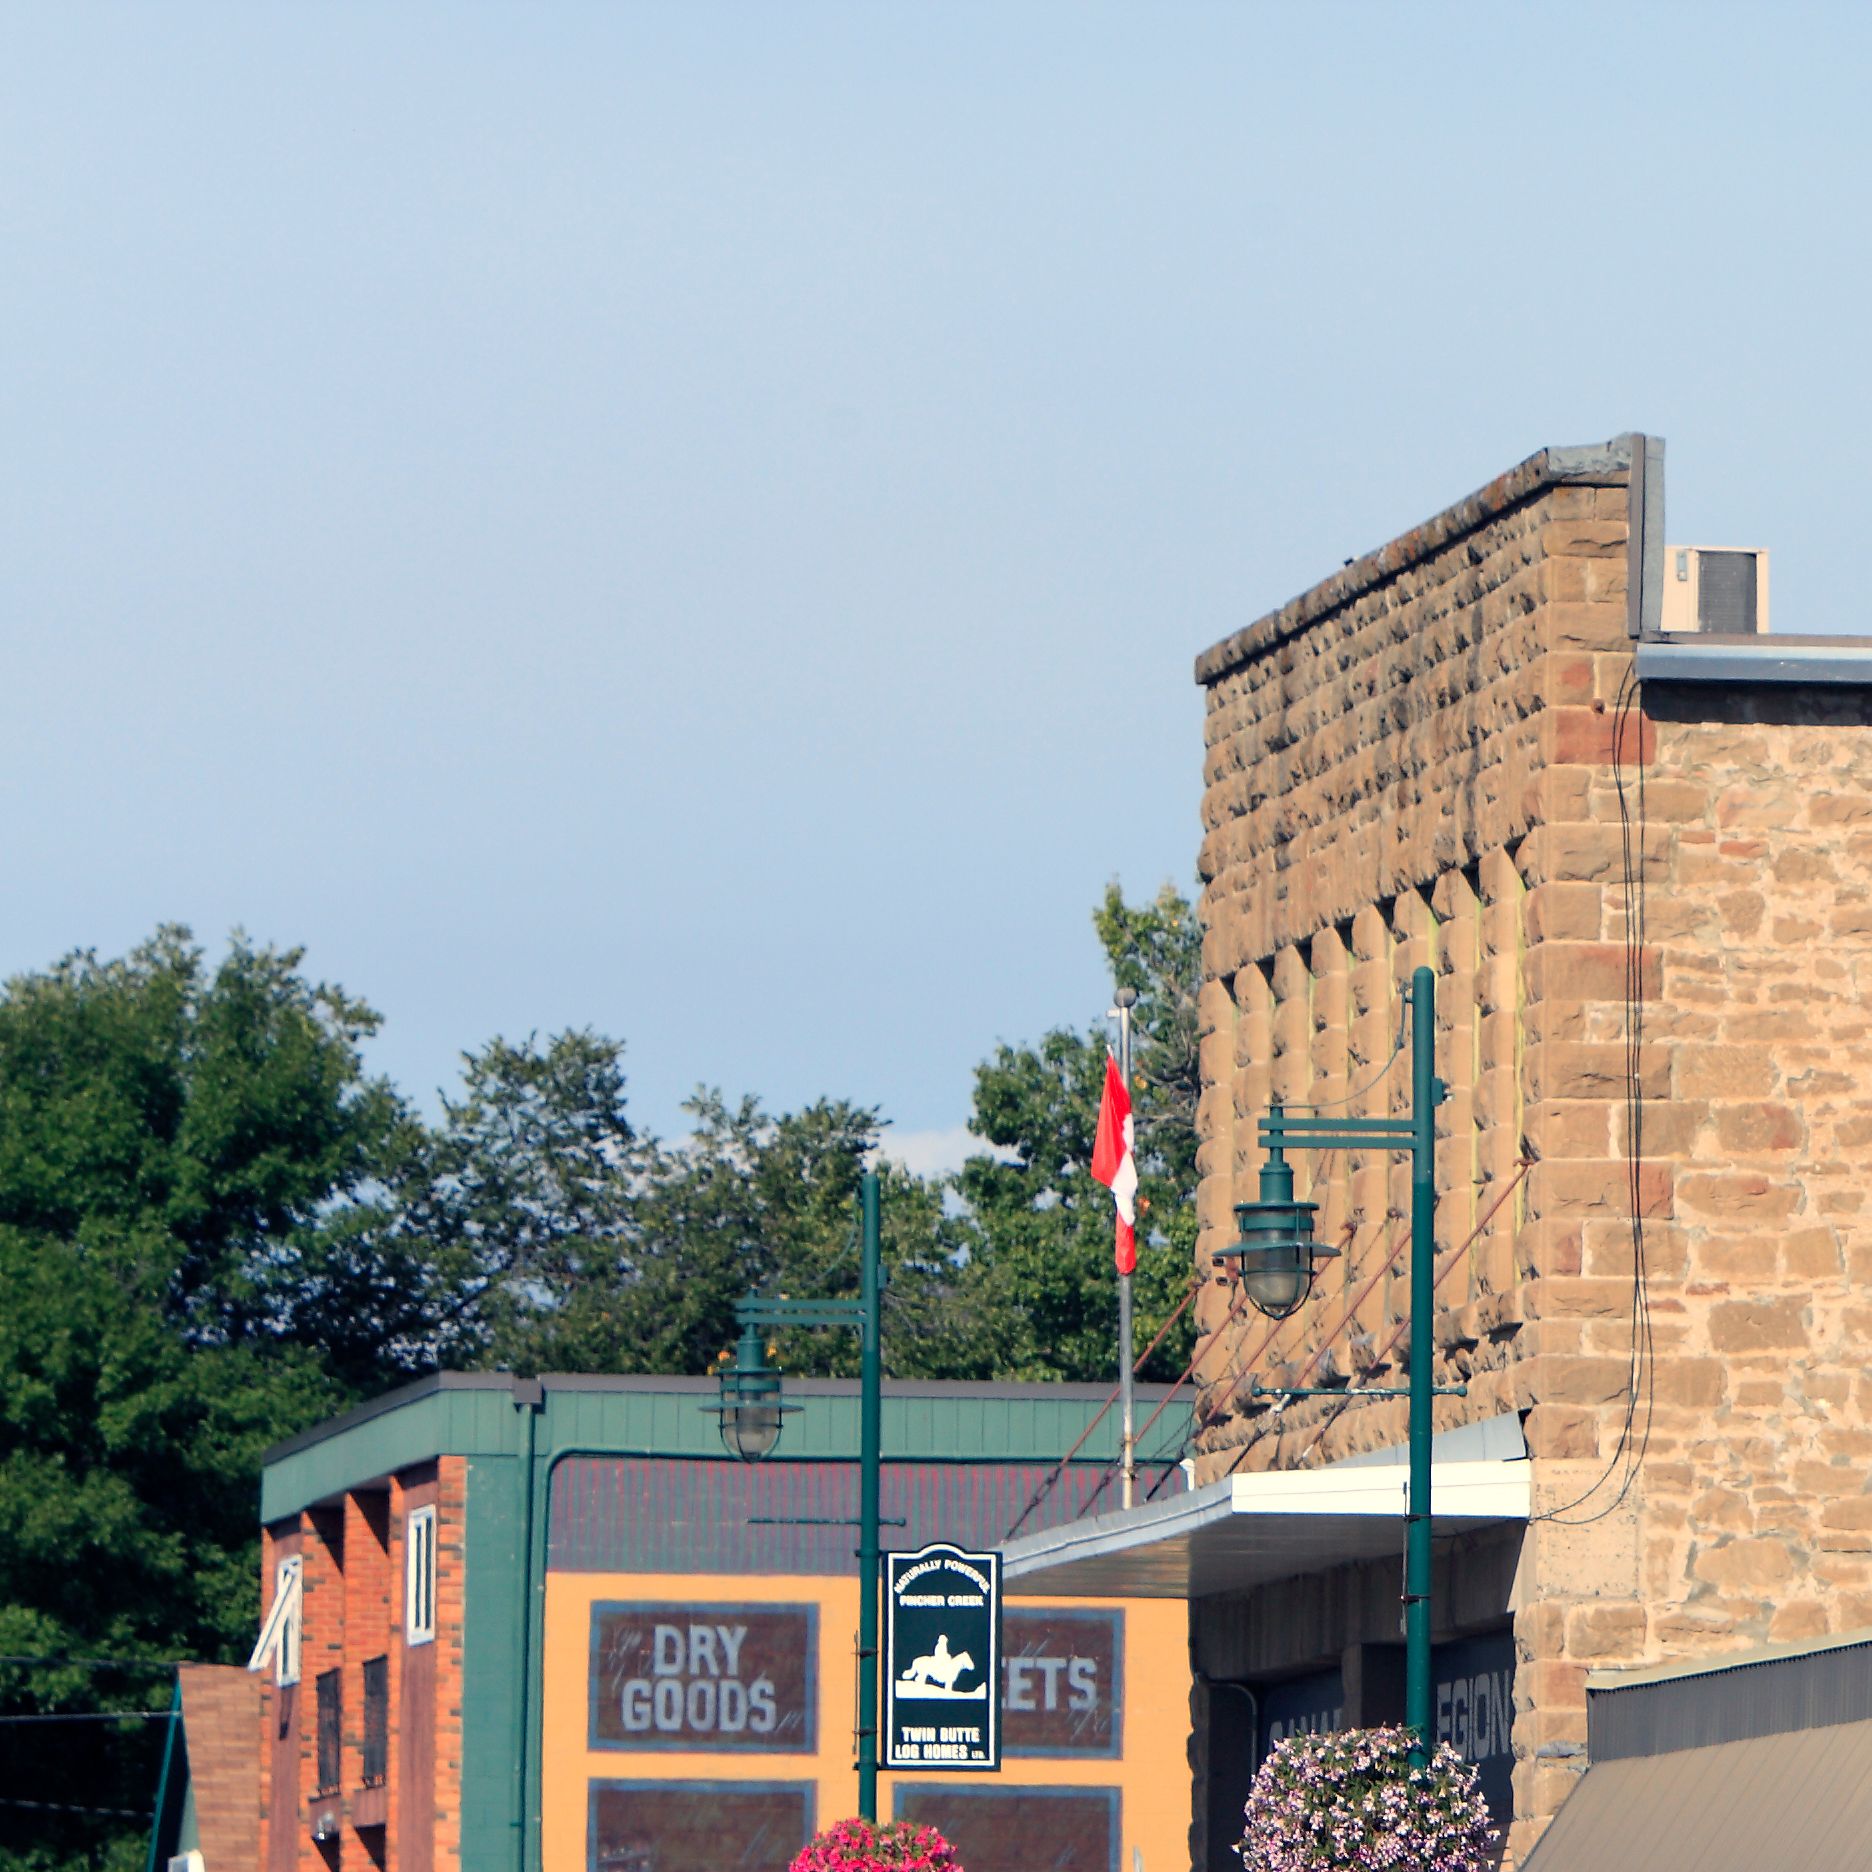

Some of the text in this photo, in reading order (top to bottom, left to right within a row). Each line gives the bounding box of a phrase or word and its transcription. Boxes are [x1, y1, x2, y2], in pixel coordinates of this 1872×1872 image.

[893, 1559, 991, 1594] NATURALLY POWERFUL
[899, 1595, 984, 1607] PINCHER CREEK
[654, 1623, 748, 1677] DRY
[1001, 1656, 1098, 1711] ETS
[621, 1679, 778, 1734] GOODS
[1437, 1669, 1511, 1760] EGION
[895, 1744, 920, 1760] LOG
[923, 1744, 968, 1760] HOMES
[901, 1727, 980, 1743] TWIN BUTTE
